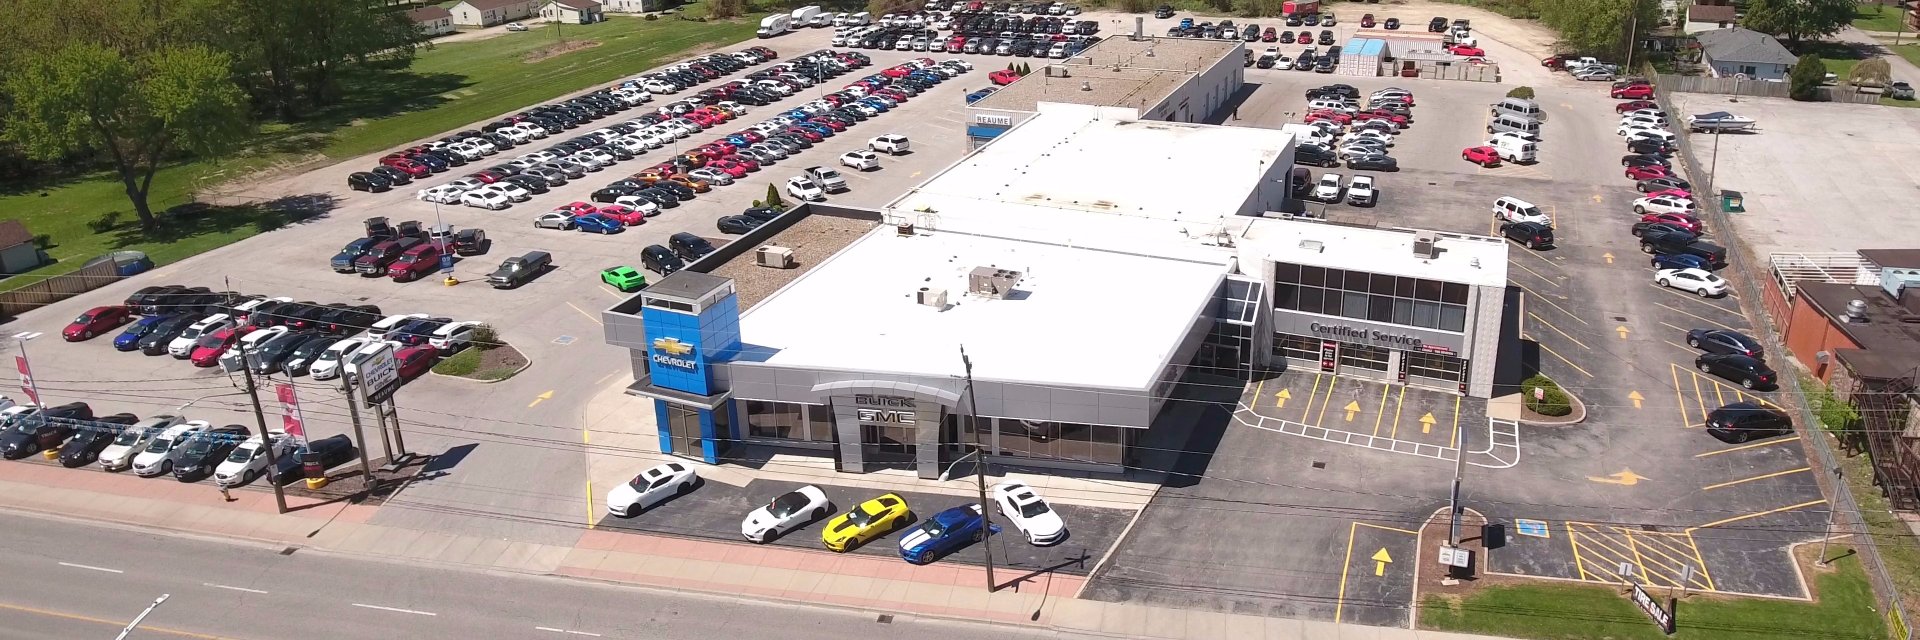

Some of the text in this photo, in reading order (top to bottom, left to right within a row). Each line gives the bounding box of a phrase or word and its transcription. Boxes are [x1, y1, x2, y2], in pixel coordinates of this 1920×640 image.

[1310, 322, 1422, 346] Certified Service
[652, 354, 696, 370] CHEVROLET
[366, 364, 395, 387] BUICK
[855, 394, 917, 408] BUICK
[857, 408, 917, 426] GMC
[1635, 586, 1669, 626] TIRE SALE
